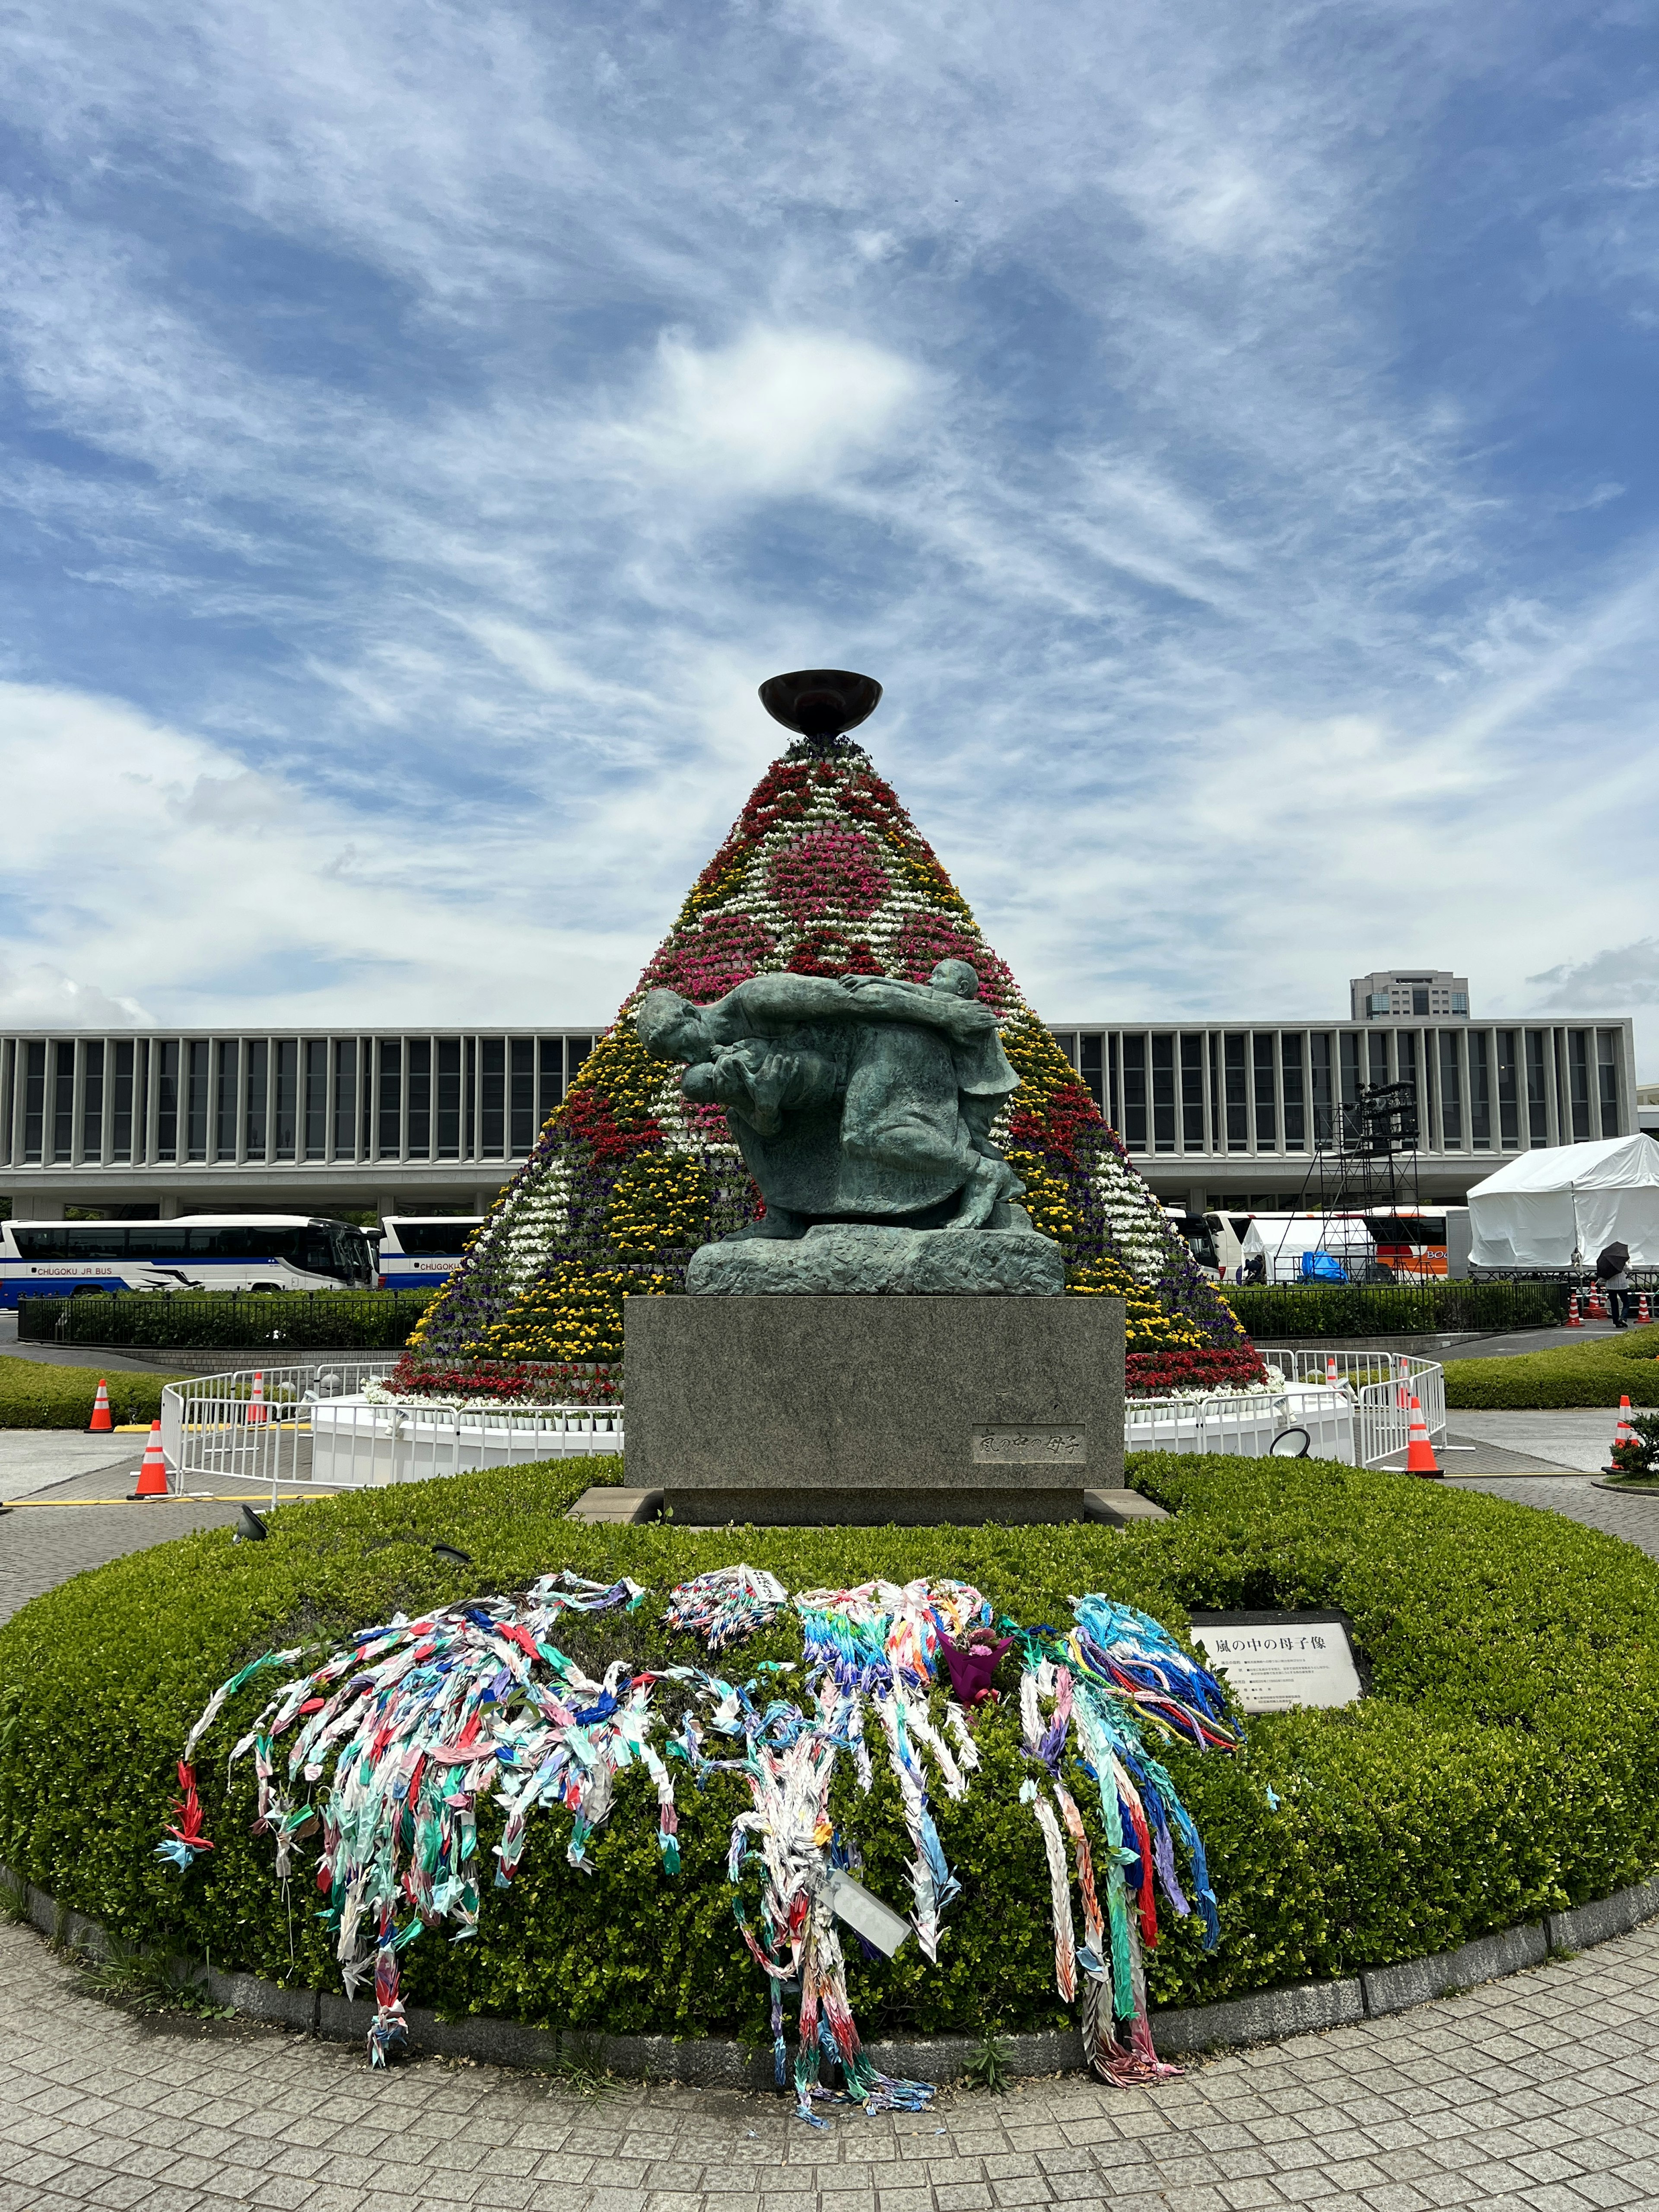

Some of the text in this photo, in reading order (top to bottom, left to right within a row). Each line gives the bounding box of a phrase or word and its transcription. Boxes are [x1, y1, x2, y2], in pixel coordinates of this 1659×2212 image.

[979, 1428, 1080, 1455] 嵐の中の母子
[1215, 1636, 1327, 1653] 嵐の中の母子像
